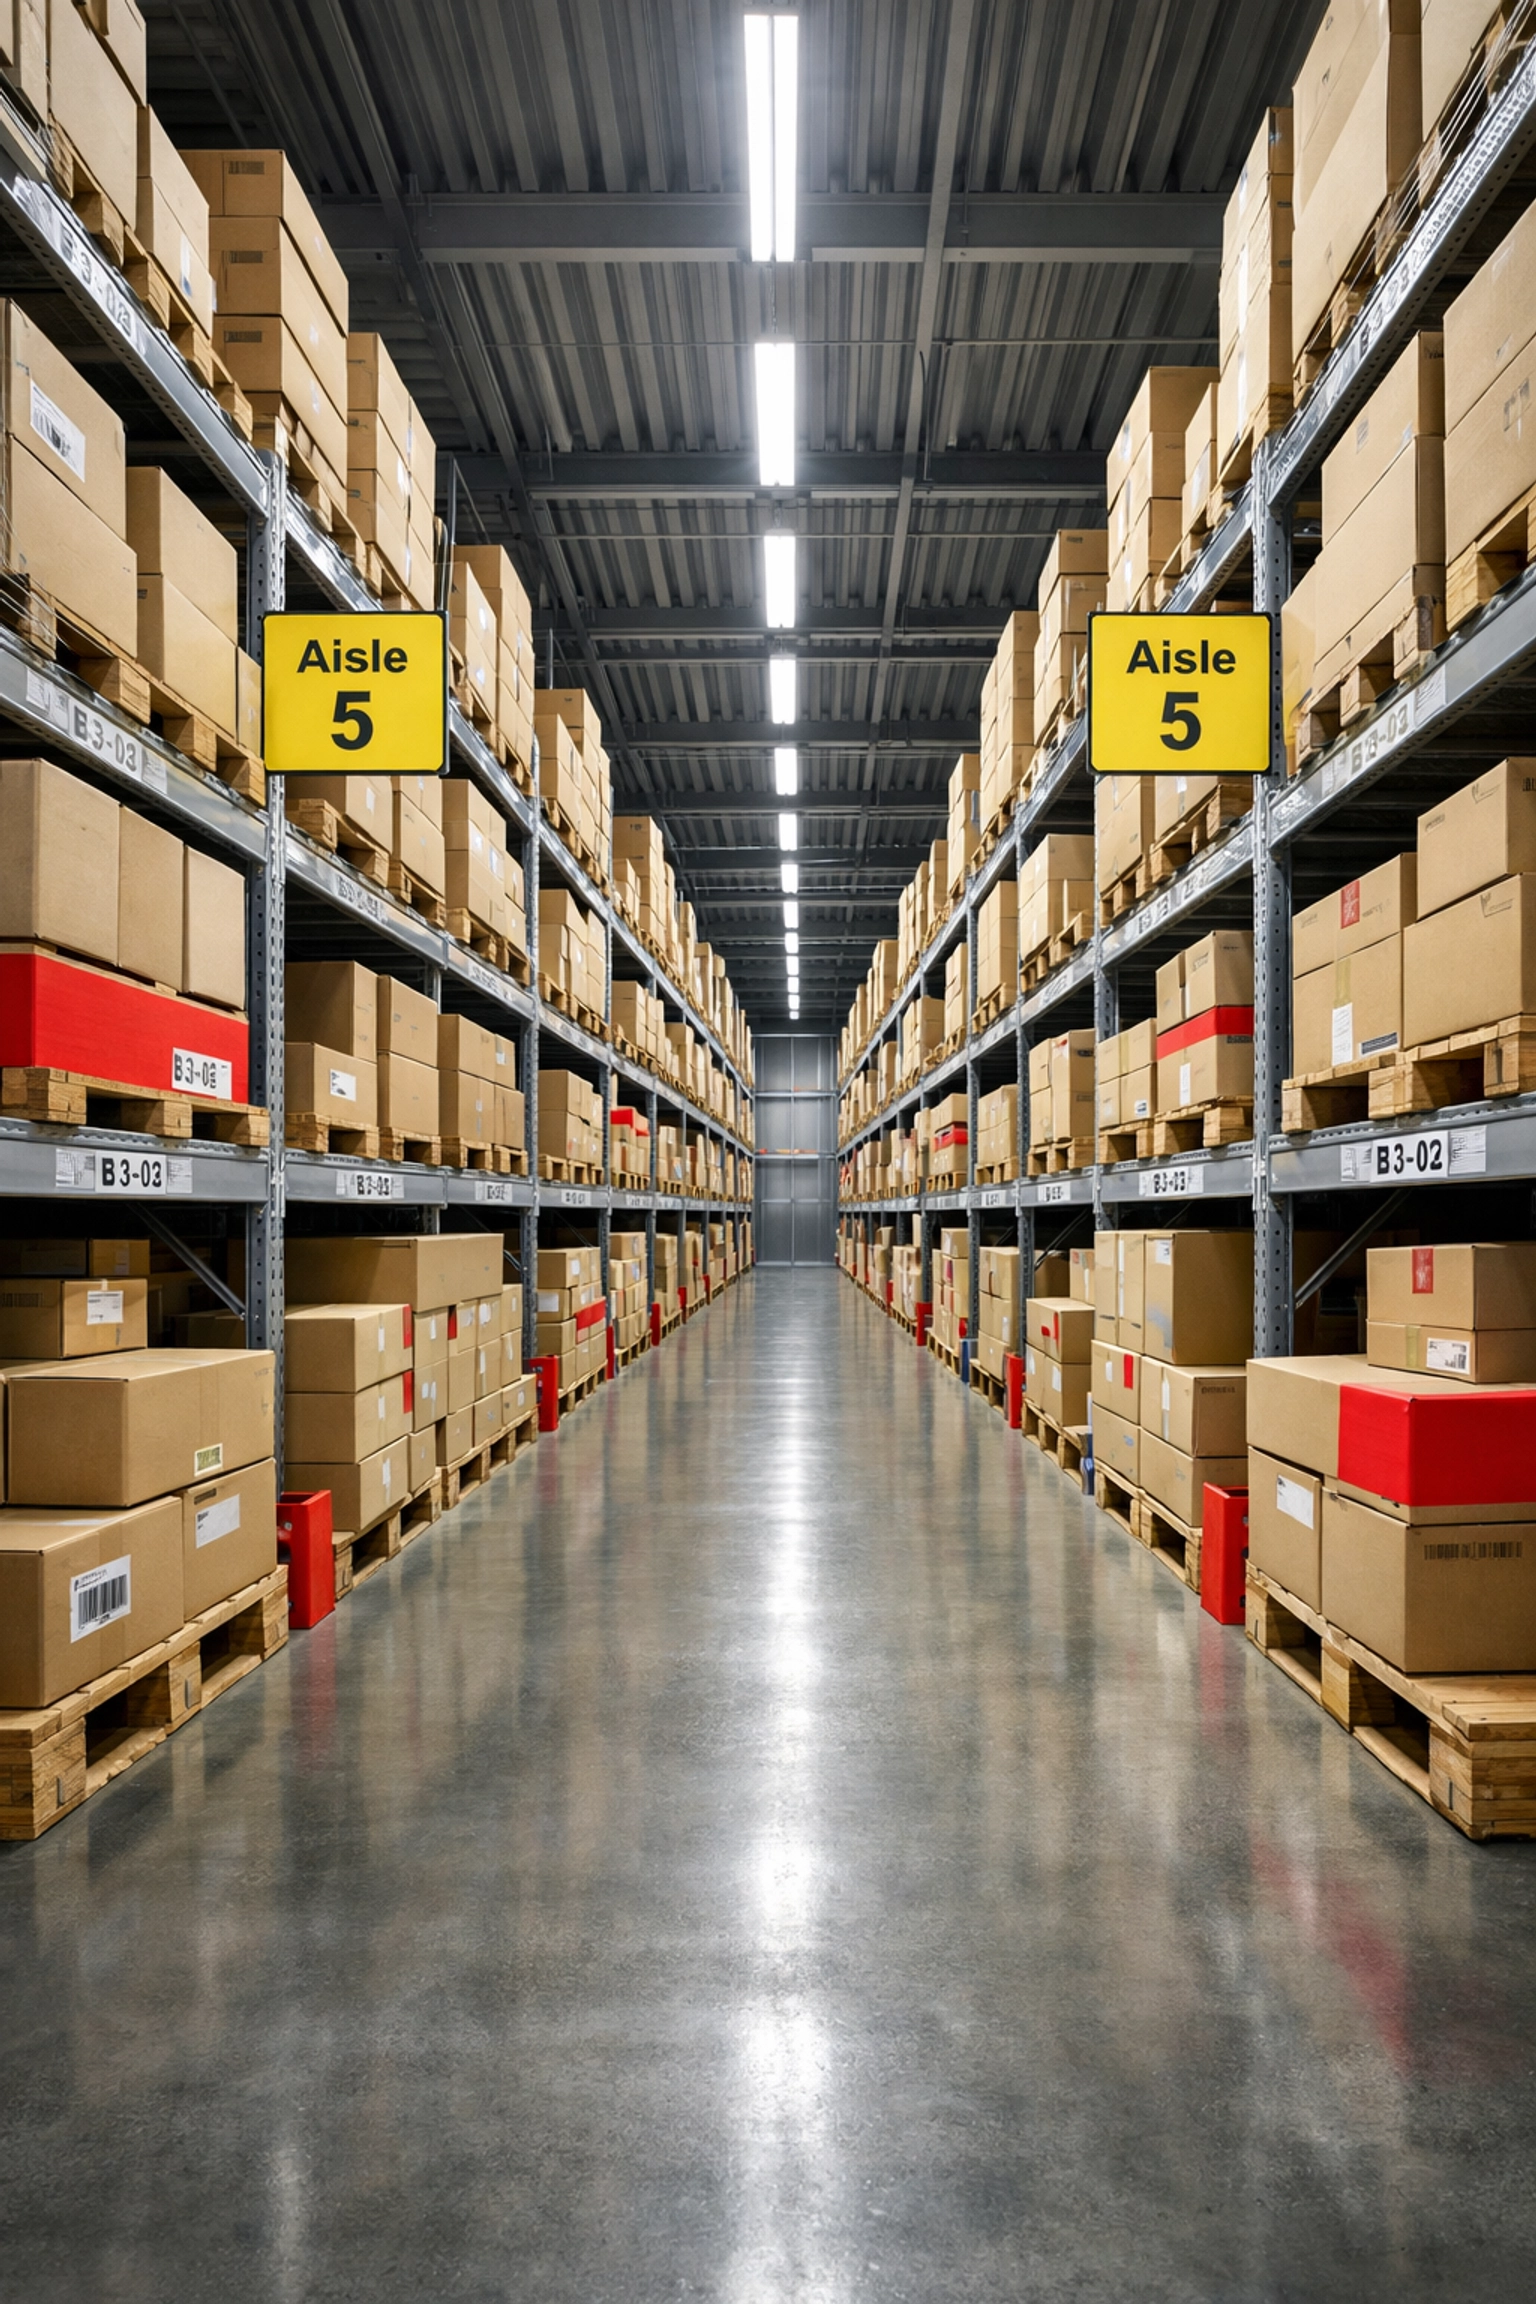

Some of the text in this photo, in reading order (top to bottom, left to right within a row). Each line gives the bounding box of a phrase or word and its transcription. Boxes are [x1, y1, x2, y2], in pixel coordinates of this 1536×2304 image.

[296, 638, 408, 673] Aisle
[1126, 639, 1236, 675] Aisle
[331, 690, 374, 751] 5
[1159, 691, 1202, 751] 5
[1376, 1138, 1443, 1176] B3-02
